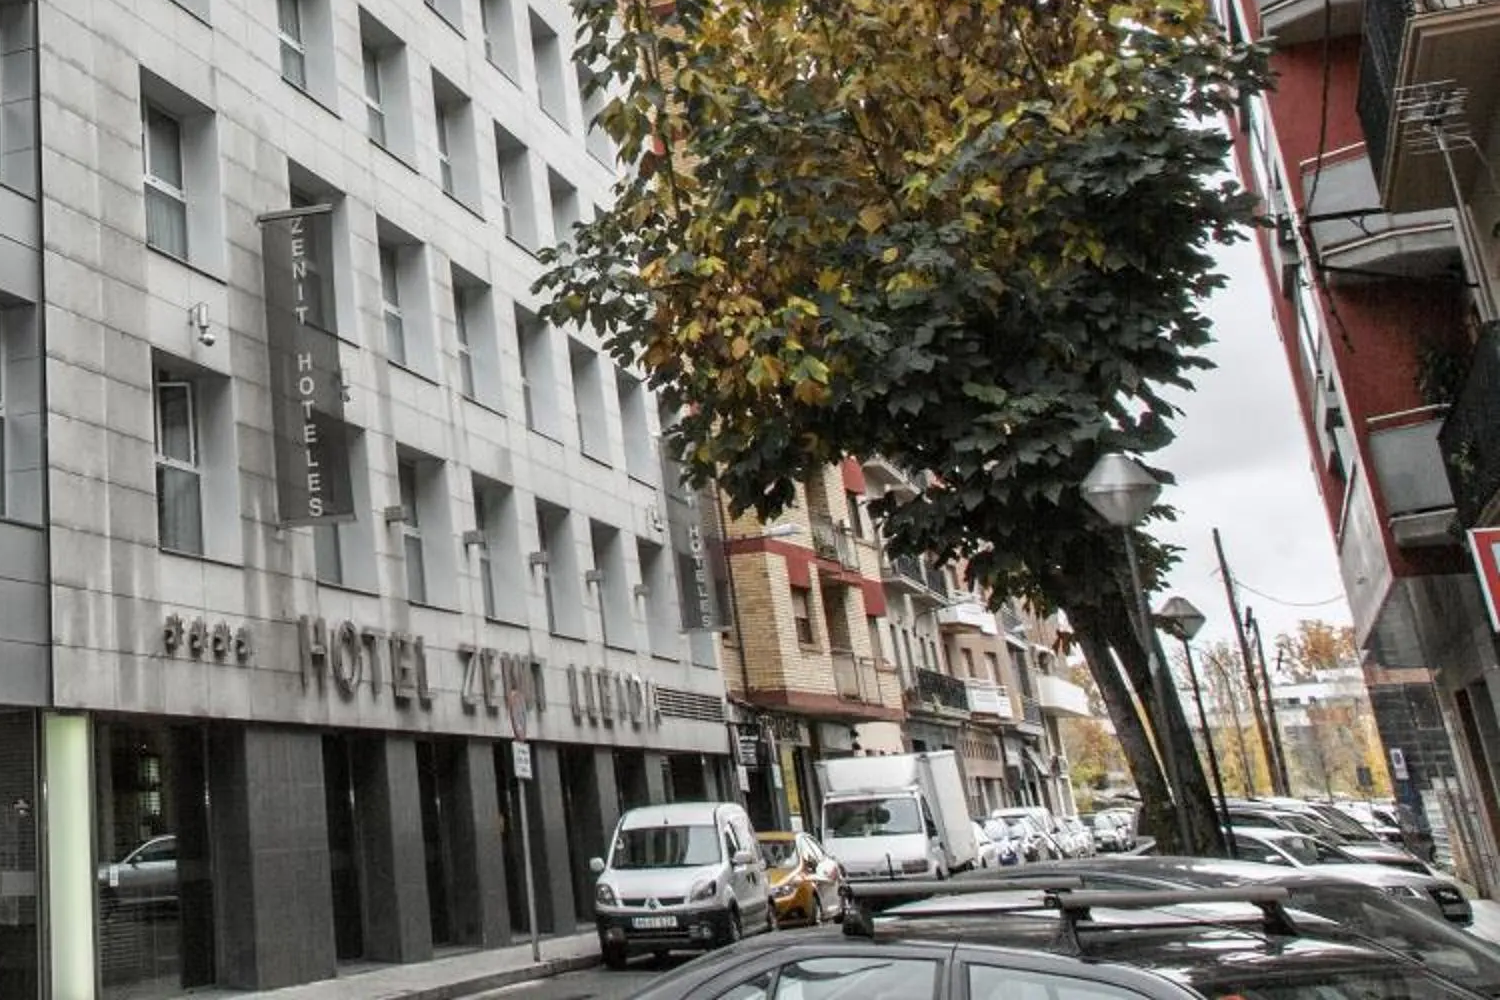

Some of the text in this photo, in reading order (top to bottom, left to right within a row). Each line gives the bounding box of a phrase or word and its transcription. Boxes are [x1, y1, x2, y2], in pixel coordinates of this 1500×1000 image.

[291, 217, 324, 518] ZENIT HOTELES
[688, 524, 711, 628] HOTELES
[299, 614, 662, 732] HOTEL ZENIT LLEIDA
